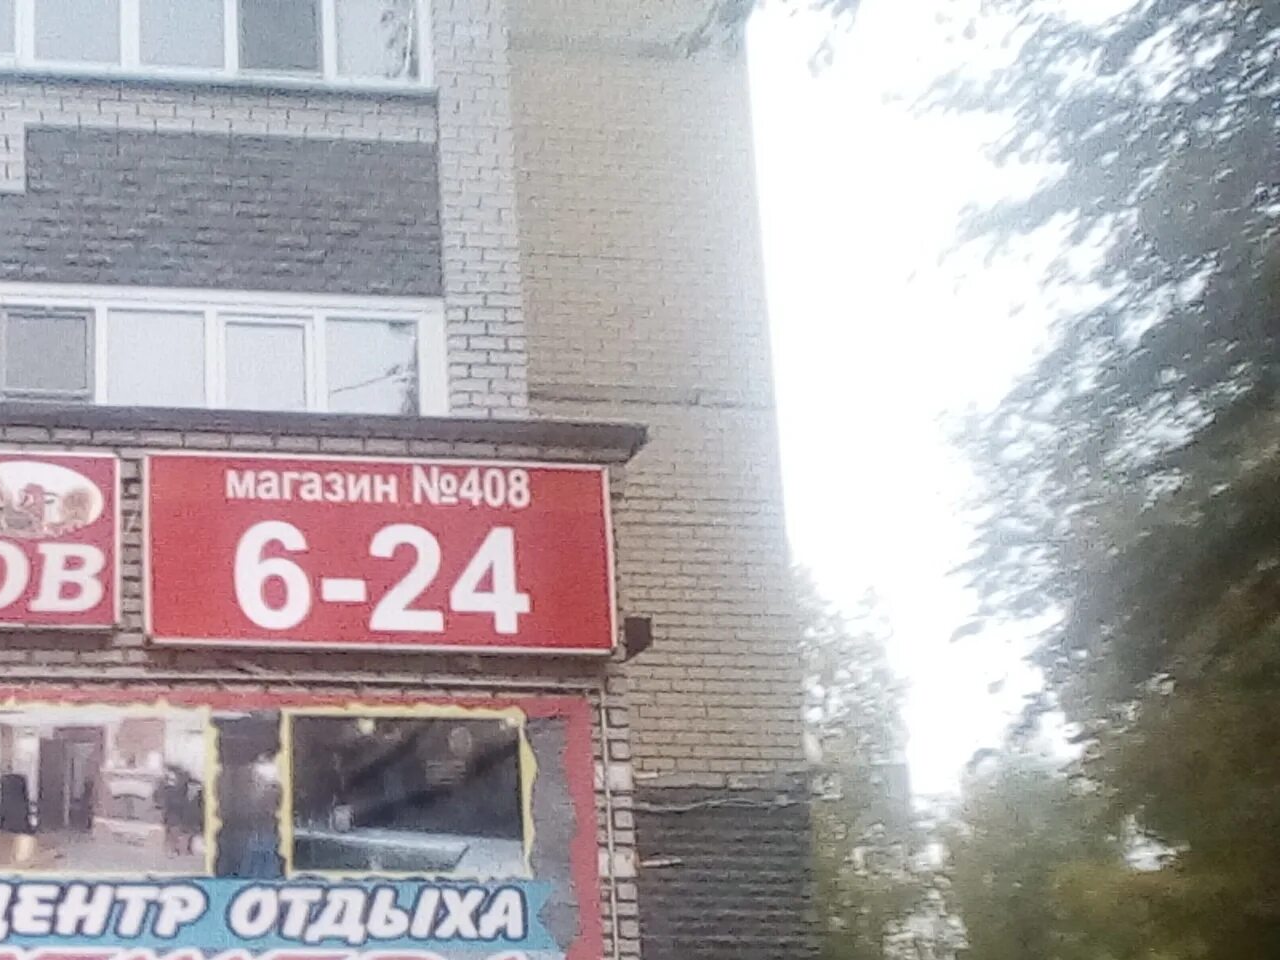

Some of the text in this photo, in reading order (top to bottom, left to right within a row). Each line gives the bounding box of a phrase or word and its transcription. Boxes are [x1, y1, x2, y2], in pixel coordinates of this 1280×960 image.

[225, 465, 531, 509] магазин №408
[234, 520, 531, 635] 6-24
[230, 884, 528, 942] ОТДЫХА
